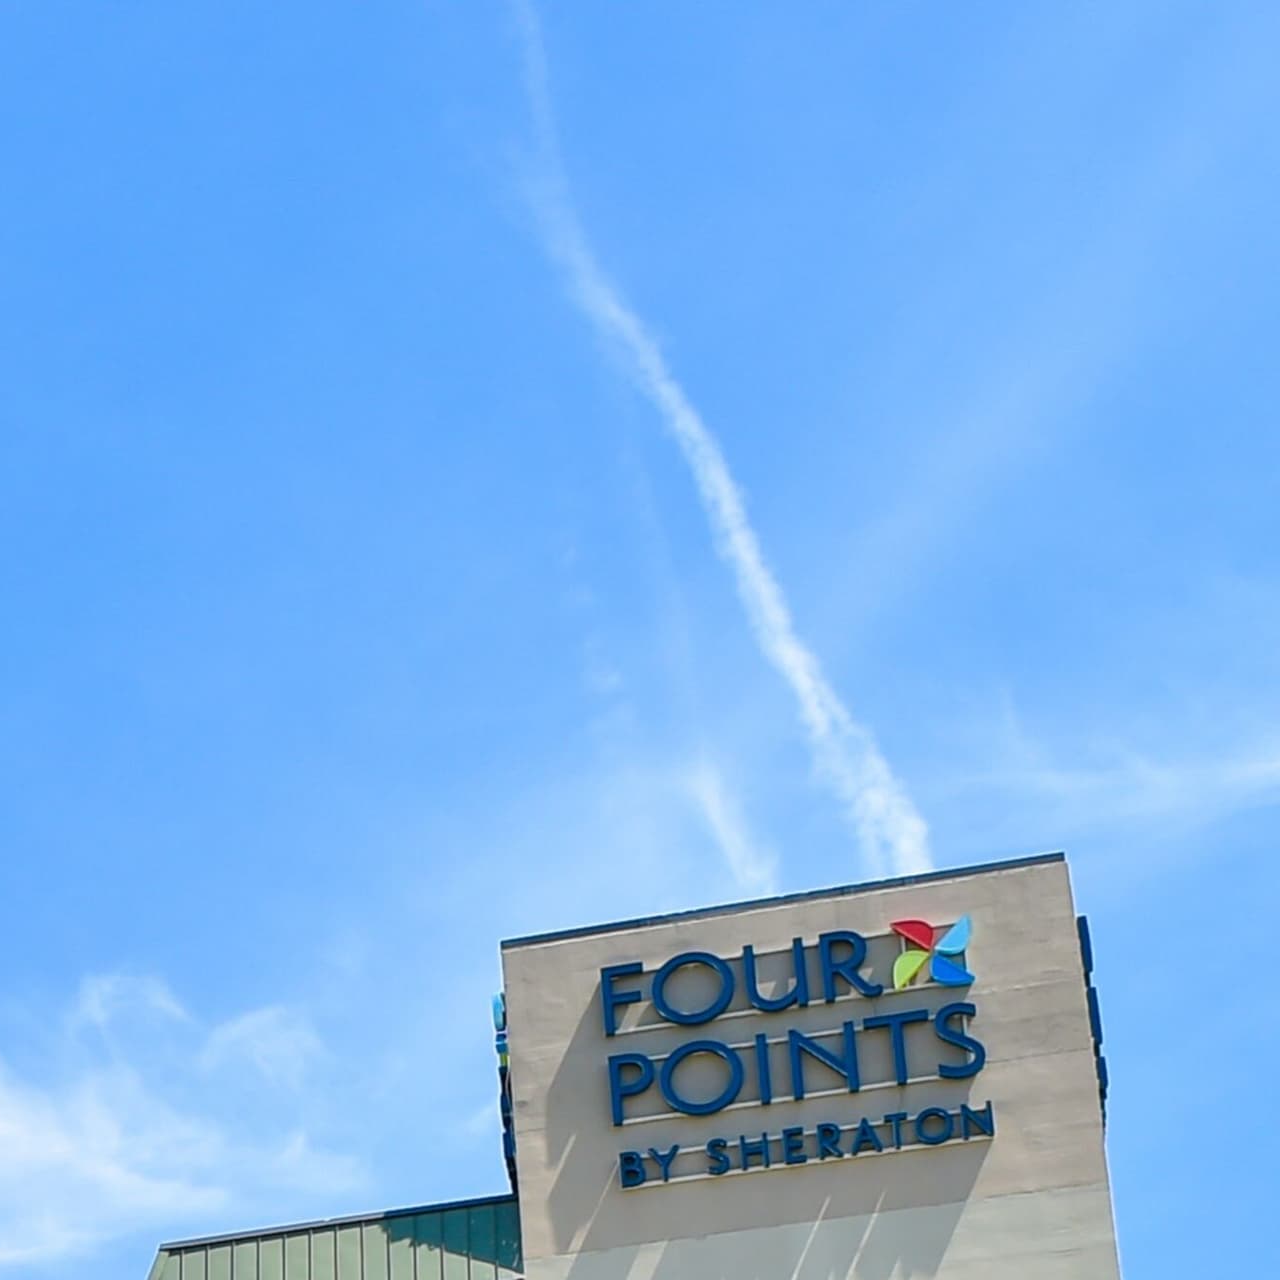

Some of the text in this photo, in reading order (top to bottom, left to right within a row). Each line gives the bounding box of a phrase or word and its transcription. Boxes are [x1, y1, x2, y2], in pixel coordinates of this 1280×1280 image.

[600, 930, 883, 1037] FOUR
[608, 1002, 987, 1127] POINTS
[618, 1099, 996, 1189] BY SHERATON
